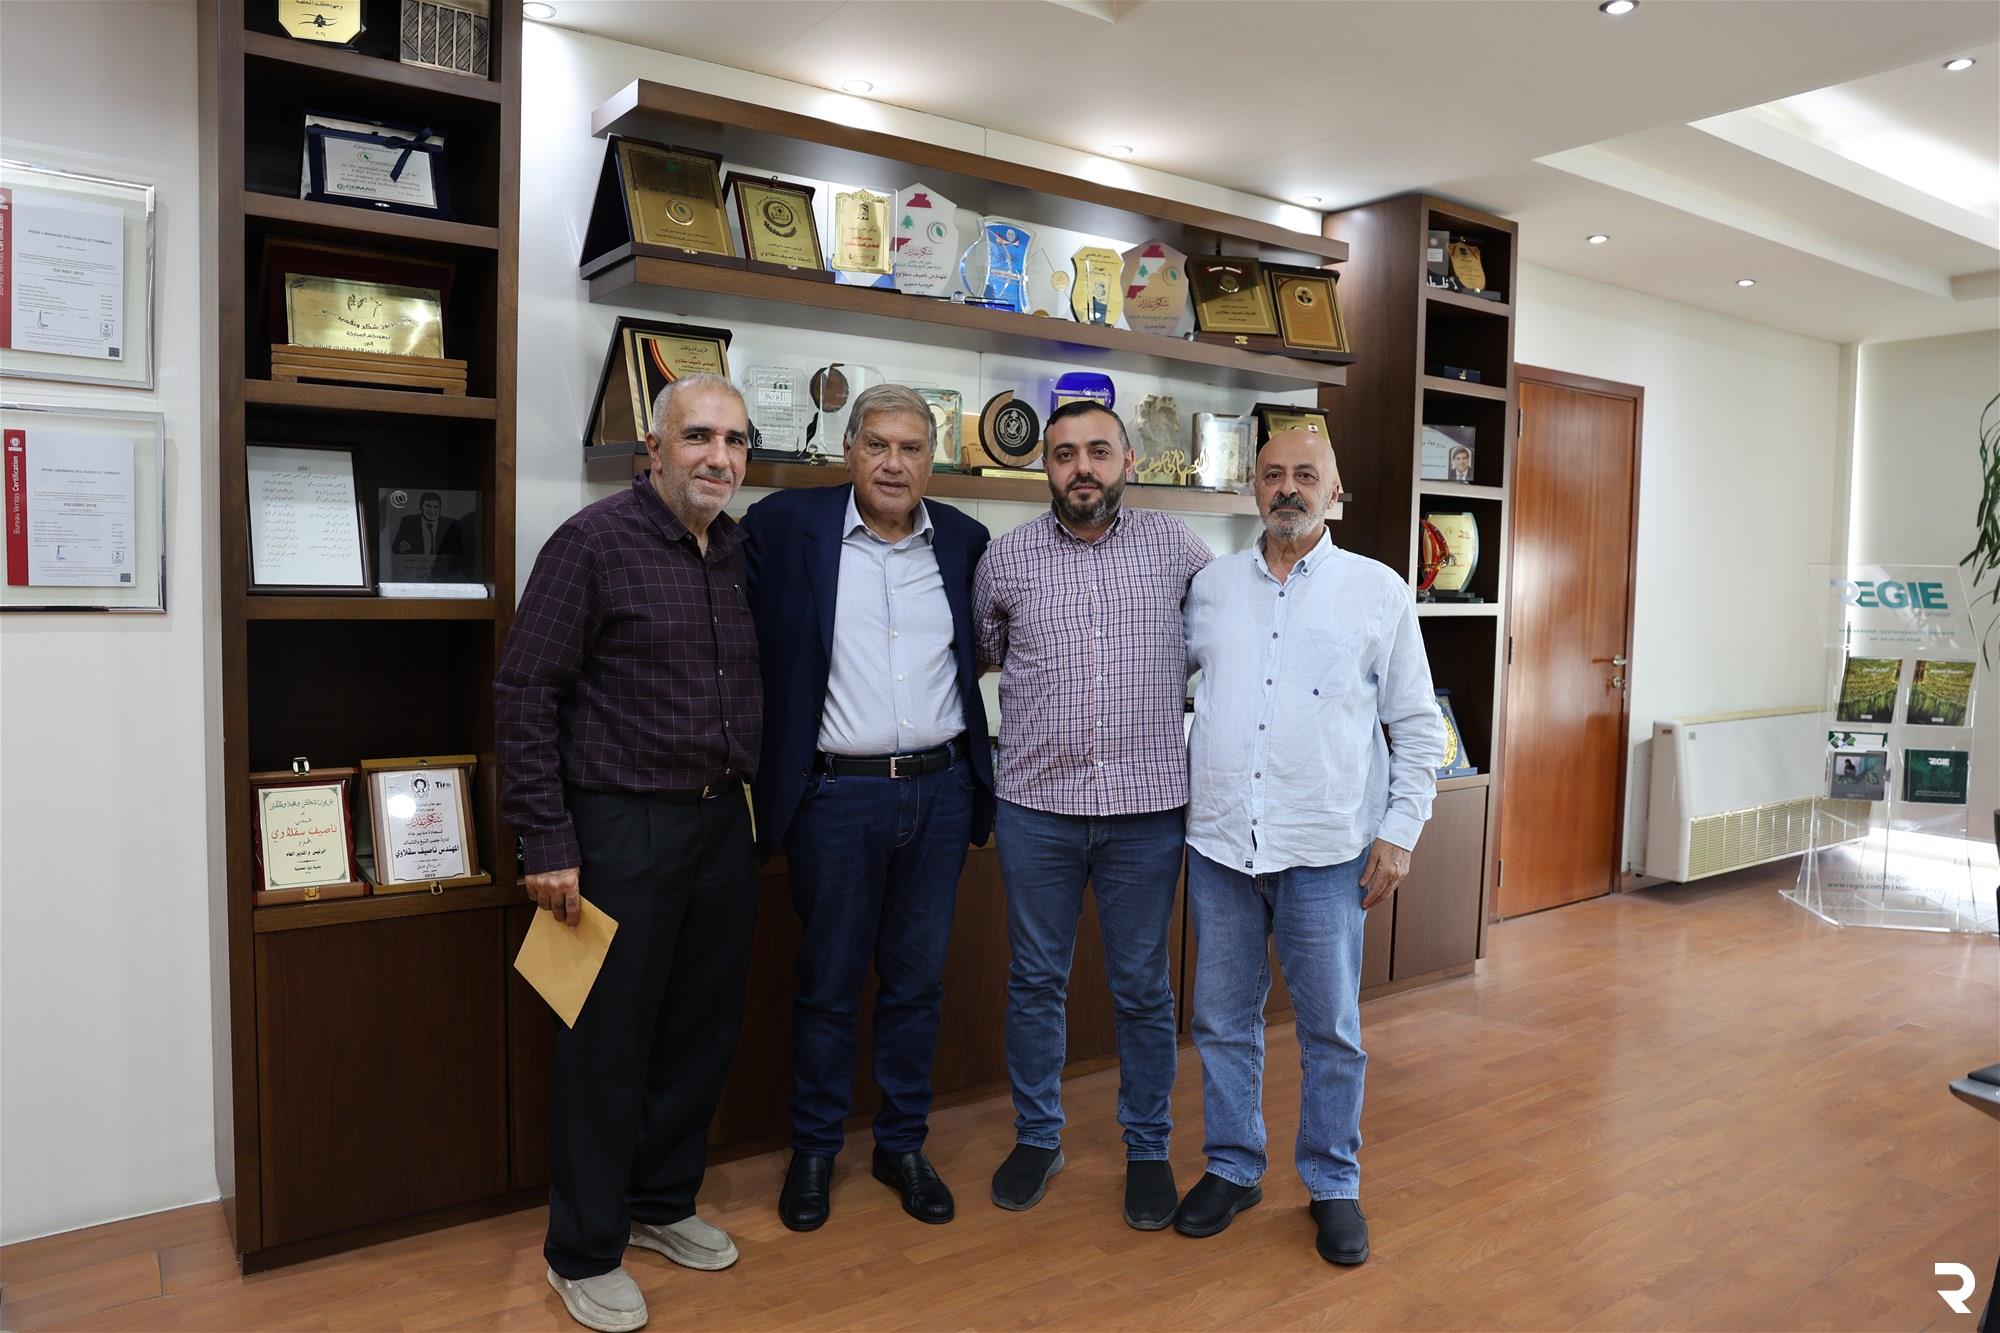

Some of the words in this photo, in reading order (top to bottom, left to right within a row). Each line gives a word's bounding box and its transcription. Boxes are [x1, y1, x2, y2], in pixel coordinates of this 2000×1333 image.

[11, 455, 20, 492] Certification
[12, 492, 20, 513] Veritas
[13, 513, 21, 535] Bureau
[1830, 579, 1949, 609] REGIE
[1928, 757, 1951, 766] REGIE
[271, 826, 306, 843] سقلاوي
[308, 824, 338, 838] ناصيف
[394, 848, 417, 859] سقلاوي
[417, 846, 438, 857] ناصيف
[438, 844, 460, 855] المهندس
